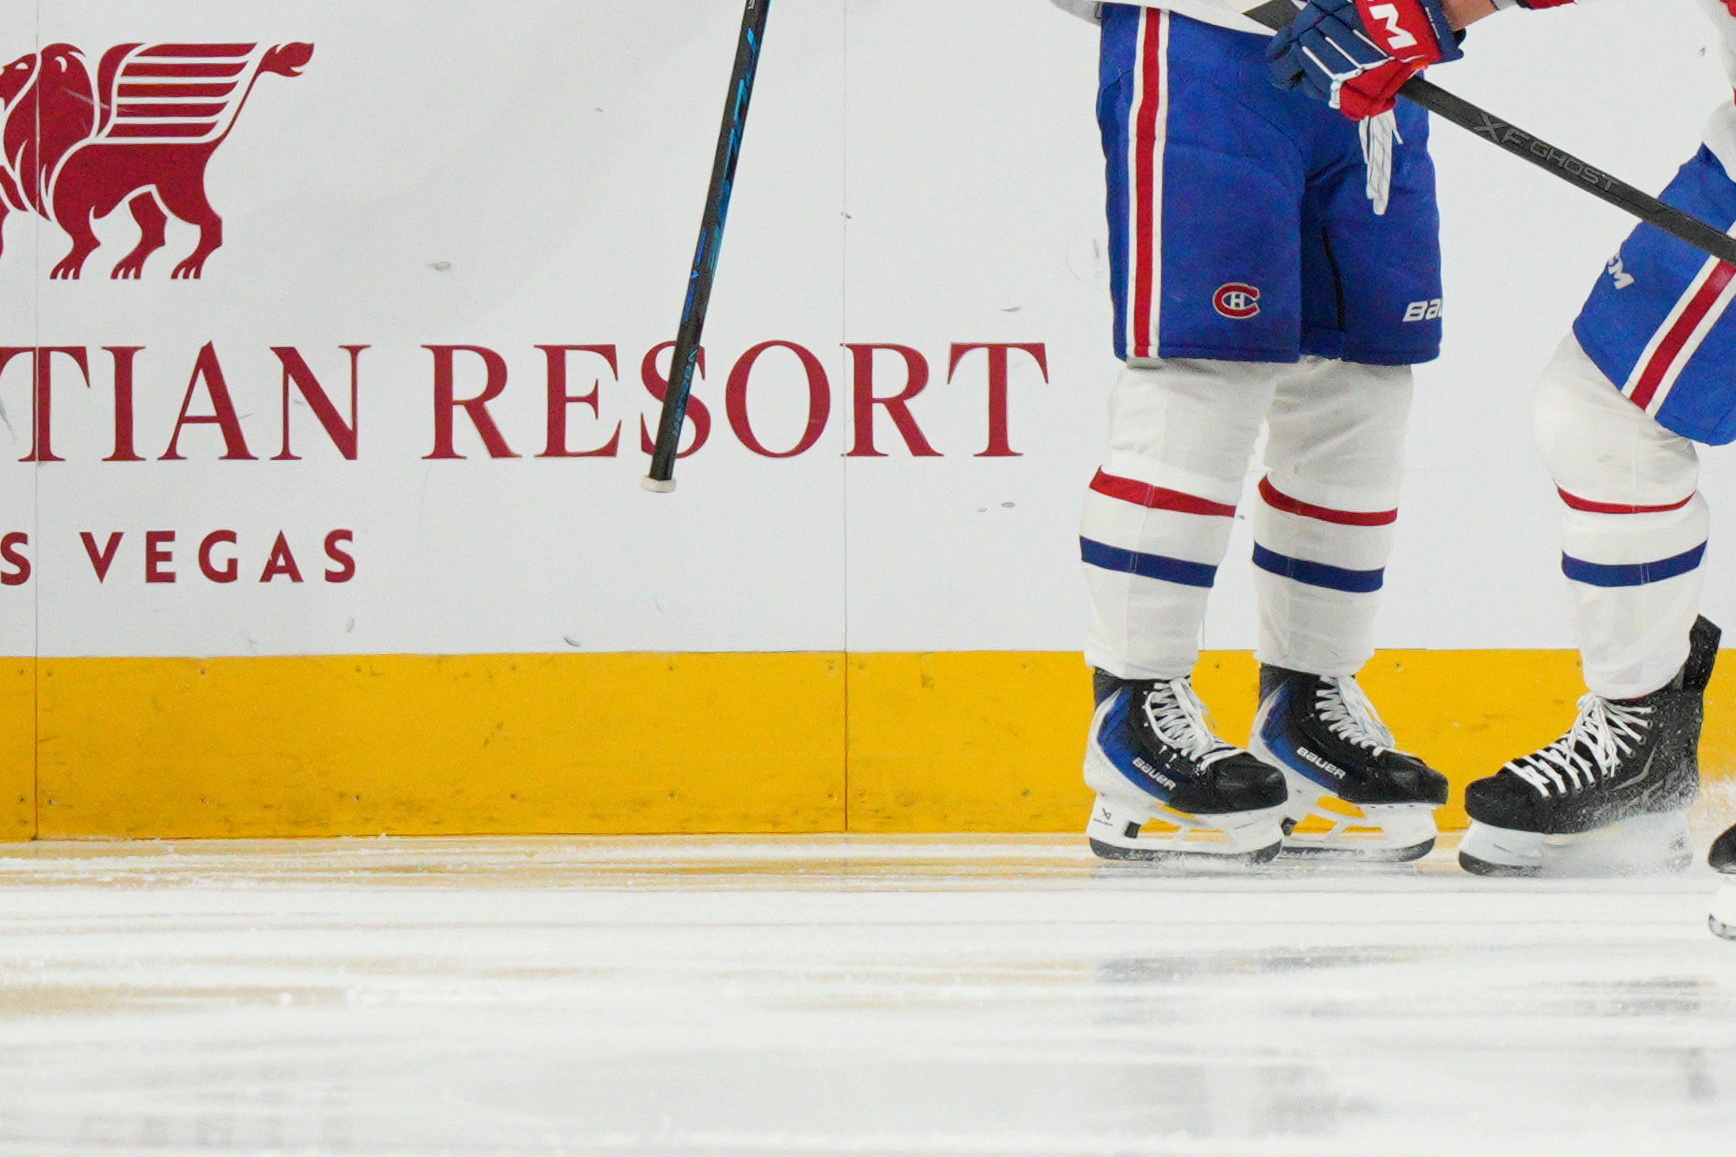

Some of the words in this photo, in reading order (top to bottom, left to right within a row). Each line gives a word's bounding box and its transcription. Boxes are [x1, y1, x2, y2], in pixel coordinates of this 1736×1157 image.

[1529, 140, 1620, 192] GHOST
[0, 339, 372, 462] TIAN
[421, 340, 1049, 460] RESORT
[78, 528, 357, 584] VEGAS
